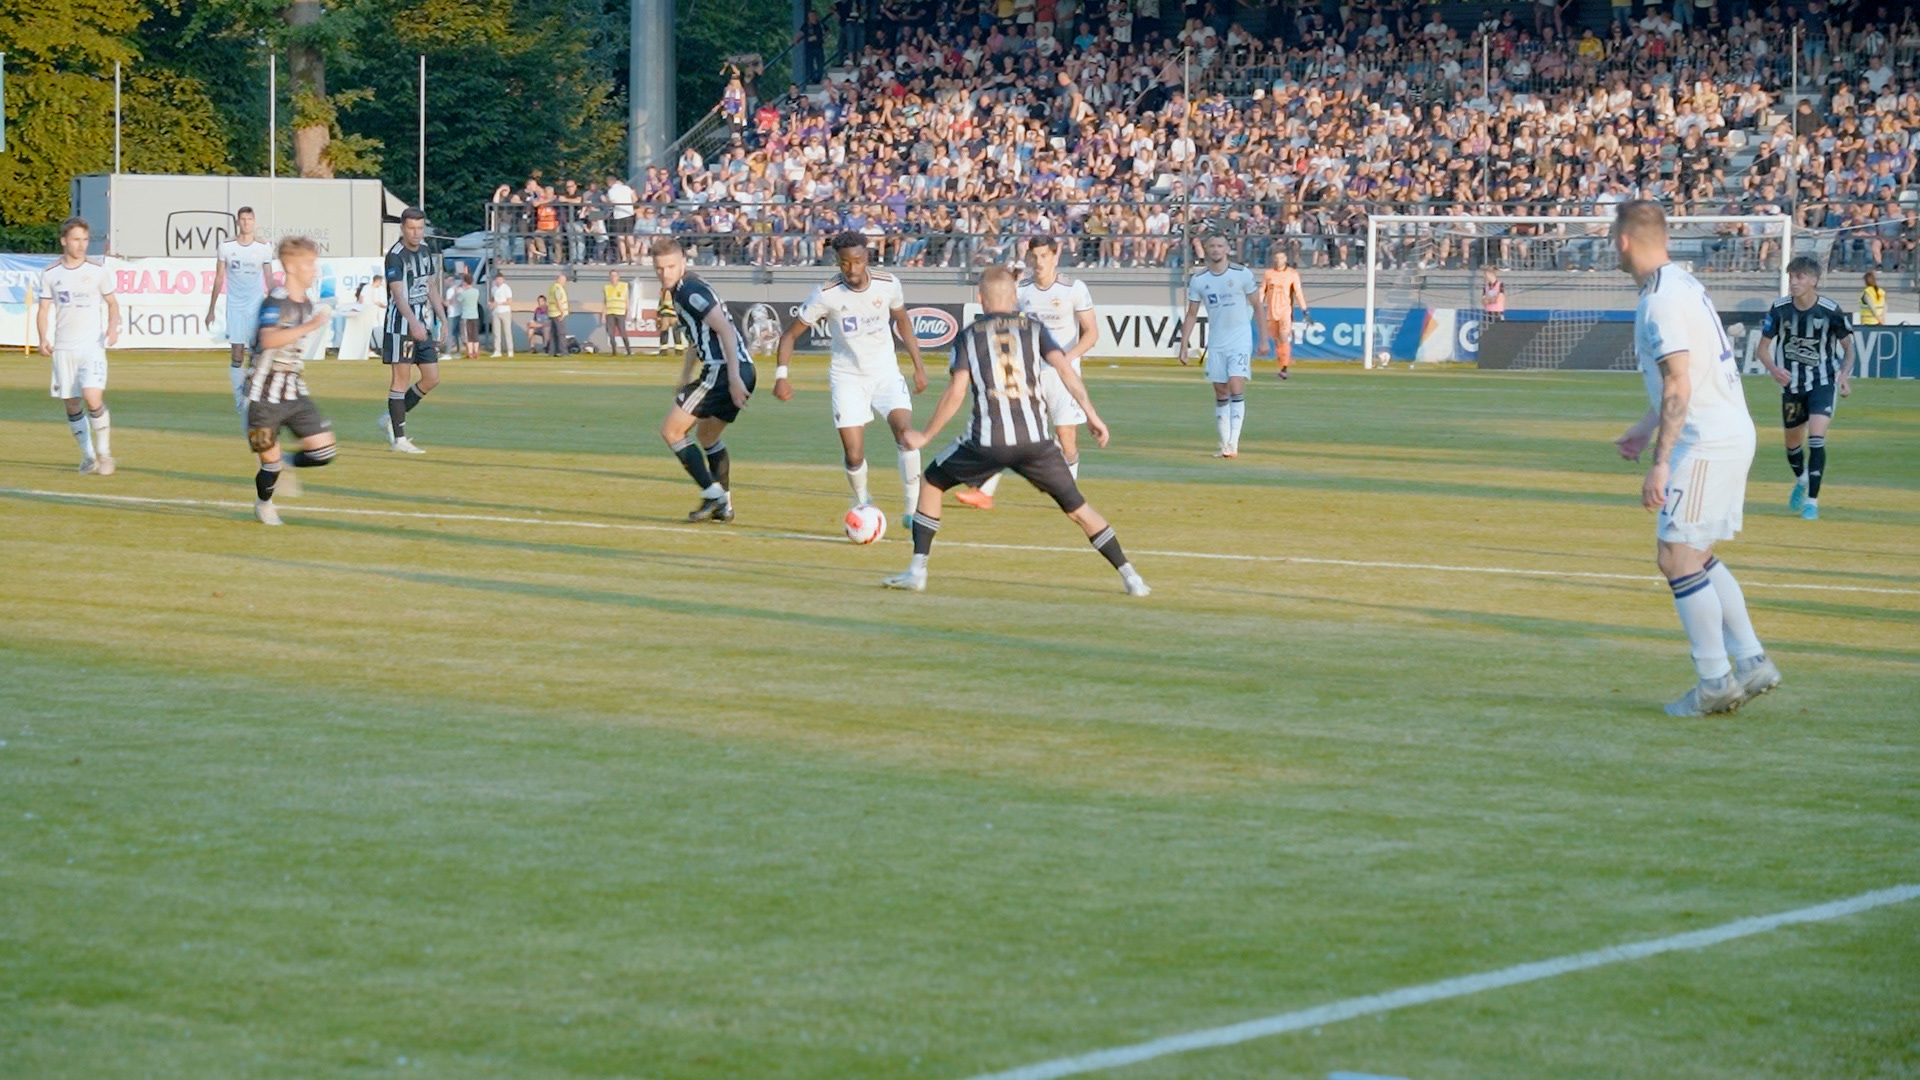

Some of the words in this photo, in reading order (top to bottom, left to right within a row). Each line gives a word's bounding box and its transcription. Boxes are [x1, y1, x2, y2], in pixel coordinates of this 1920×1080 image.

[114, 269, 196, 295] HALO
[1287, 321, 1327, 346] TC
[1237, 353, 1249, 366] 20
[1662, 488, 1684, 516] 17
